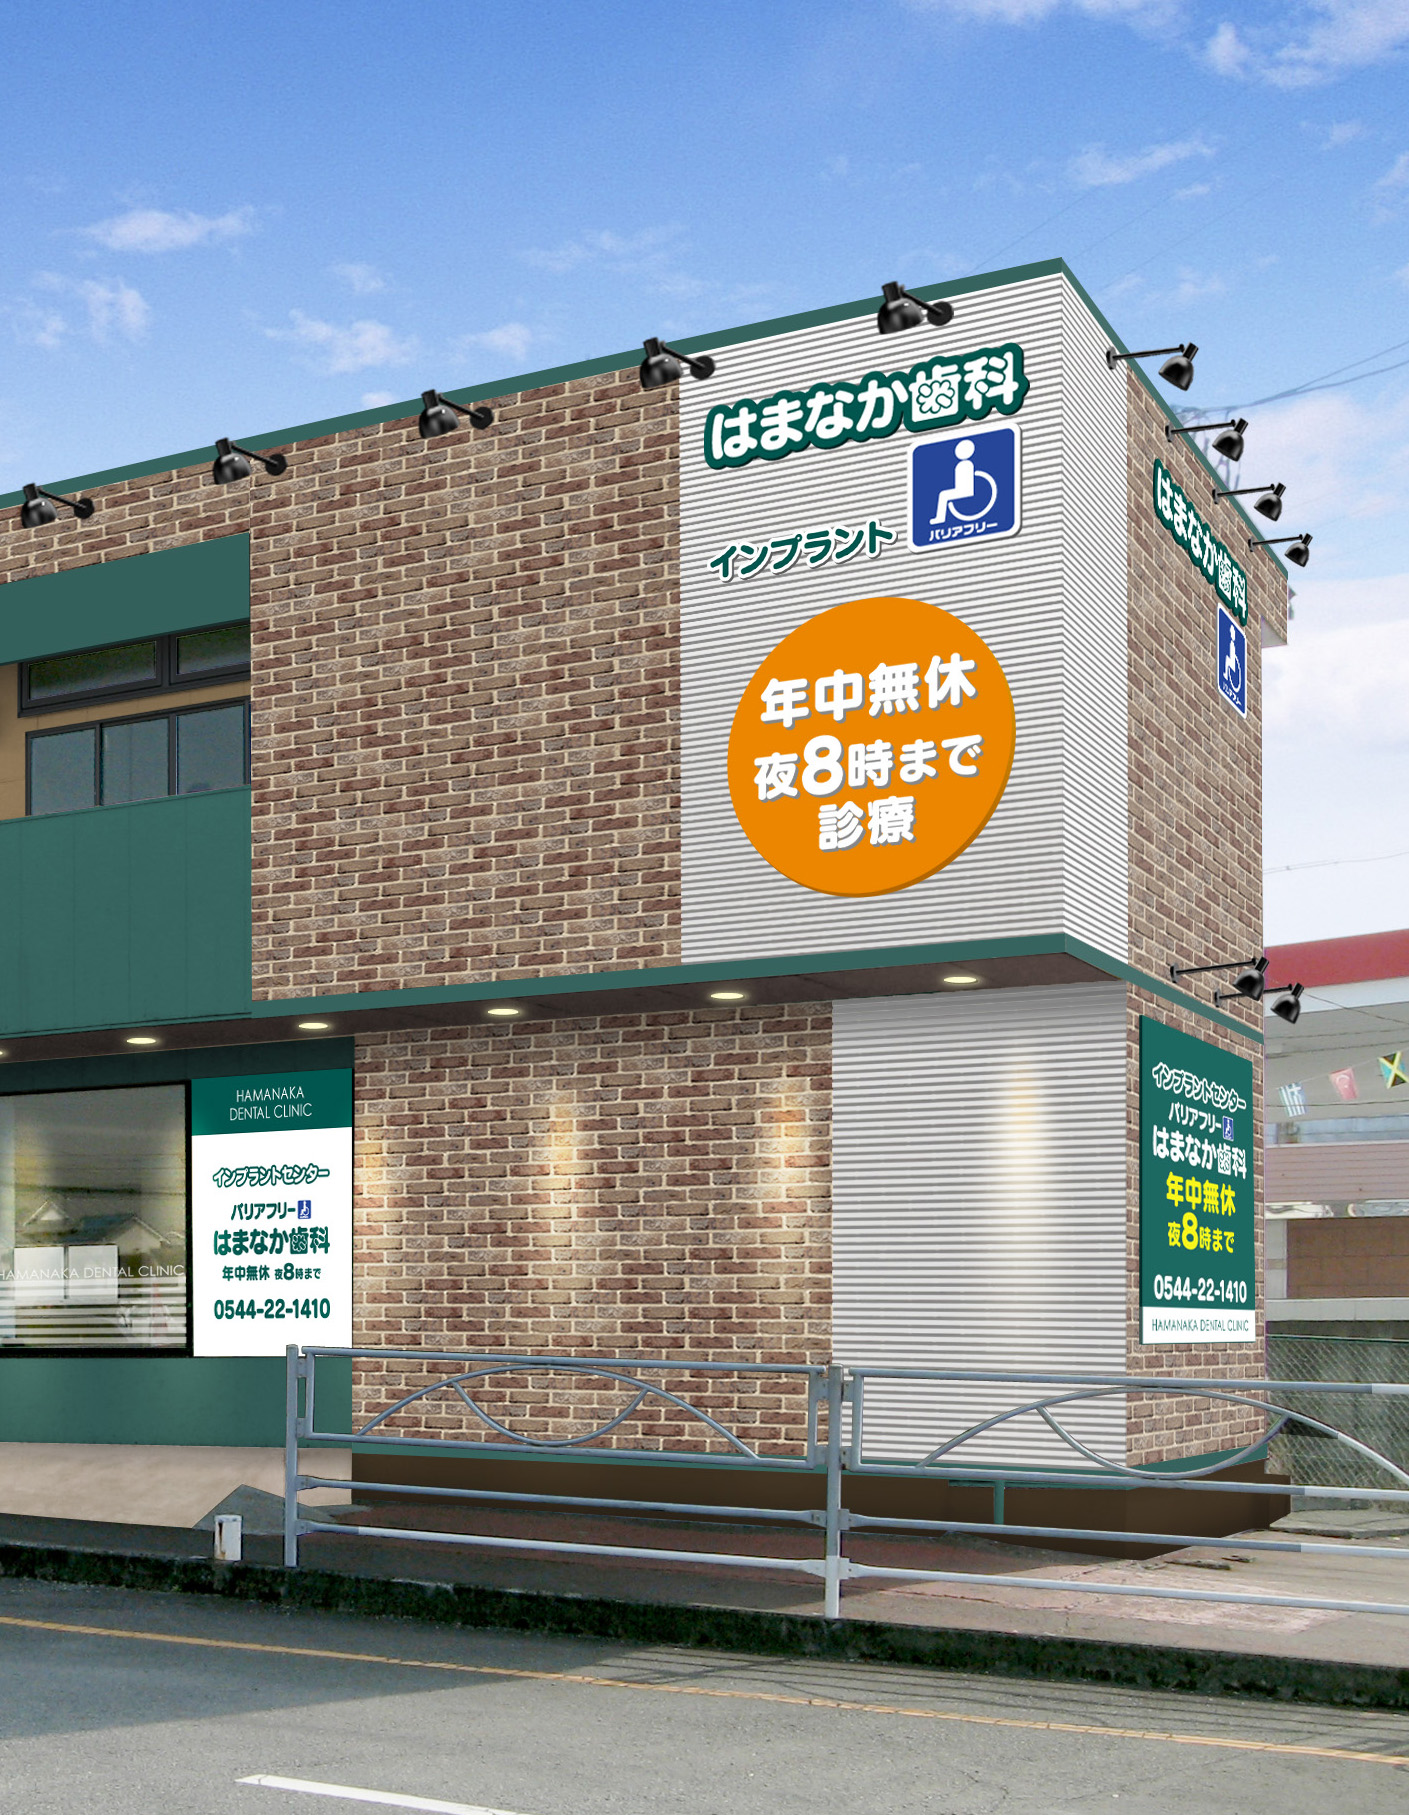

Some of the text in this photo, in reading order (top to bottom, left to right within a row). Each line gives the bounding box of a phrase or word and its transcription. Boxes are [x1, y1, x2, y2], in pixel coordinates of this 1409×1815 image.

[709, 350, 1023, 461] はまなか歯科
[928, 521, 998, 542] バリアフリー
[1156, 466, 1247, 620] はまなか歯科
[708, 520, 895, 579] インプラント
[759, 651, 978, 728] 年中無休
[752, 733, 984, 800] 夜8時まで
[816, 794, 917, 851] 診療
[236, 1086, 305, 1102] HAMANAKA
[1152, 1061, 1247, 1113] インプラントセンター
[229, 1102, 313, 1121] DENTAL CLINIC
[1168, 1101, 1222, 1134] バリアフリー
[1152, 1124, 1247, 1180] はまなか歯科
[212, 1163, 331, 1188] インプラントセンター
[1166, 1171, 1237, 1217] 年中無休
[230, 1201, 296, 1221] バリアフリー
[213, 1225, 331, 1256] はまなか歯科
[1167, 1211, 1235, 1254] 夜8時まで
[83, 1266, 134, 1279] DENTAL
[138, 1264, 185, 1277] CLINIC
[222, 1262, 322, 1282] 年中無休 夜8時まで
[1153, 1273, 1248, 1304] 0544-22-1410
[213, 1297, 331, 1320] 0544-22-1410
[1151, 1318, 1249, 1332] HAMANAKA DENTAL CLINIC
